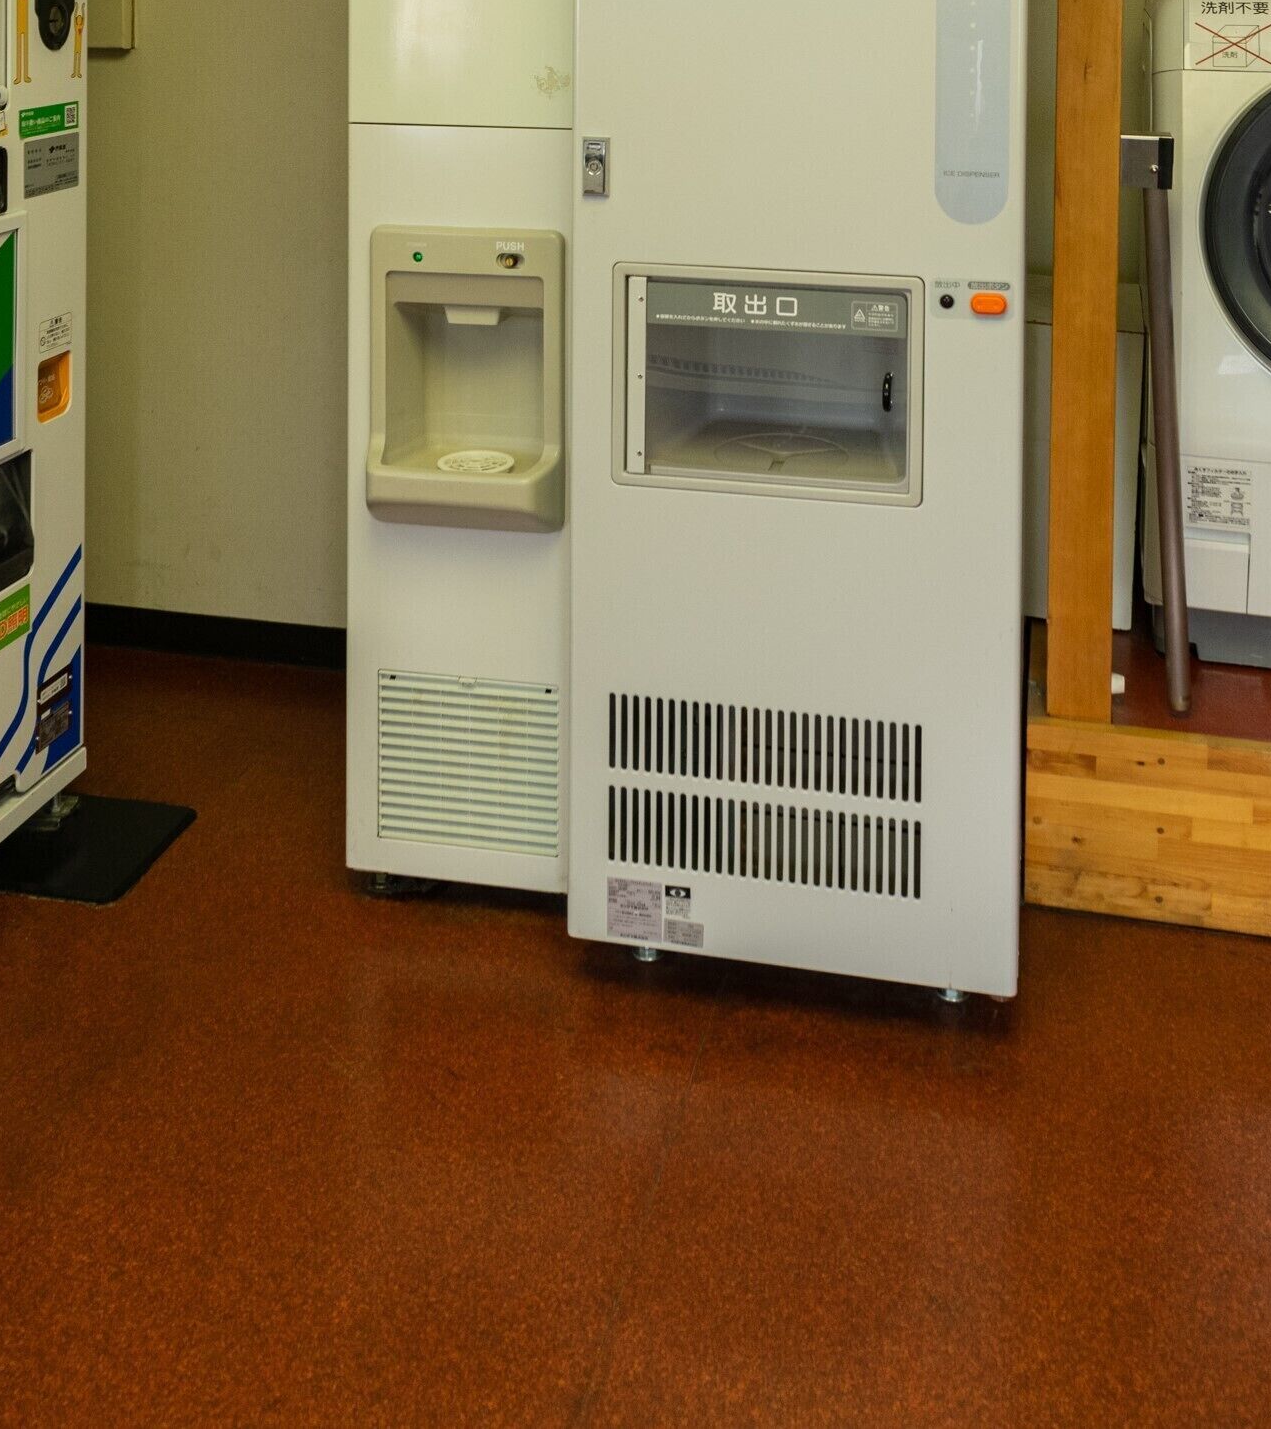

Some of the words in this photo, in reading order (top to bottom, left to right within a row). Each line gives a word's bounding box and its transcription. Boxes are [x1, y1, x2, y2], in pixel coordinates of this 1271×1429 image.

[1200, 0, 1270, 16] 洗剤不要
[1221, 51, 1238, 59] 洗剤
[495, 241, 525, 251] PUSH
[712, 291, 798, 317] 取出口
